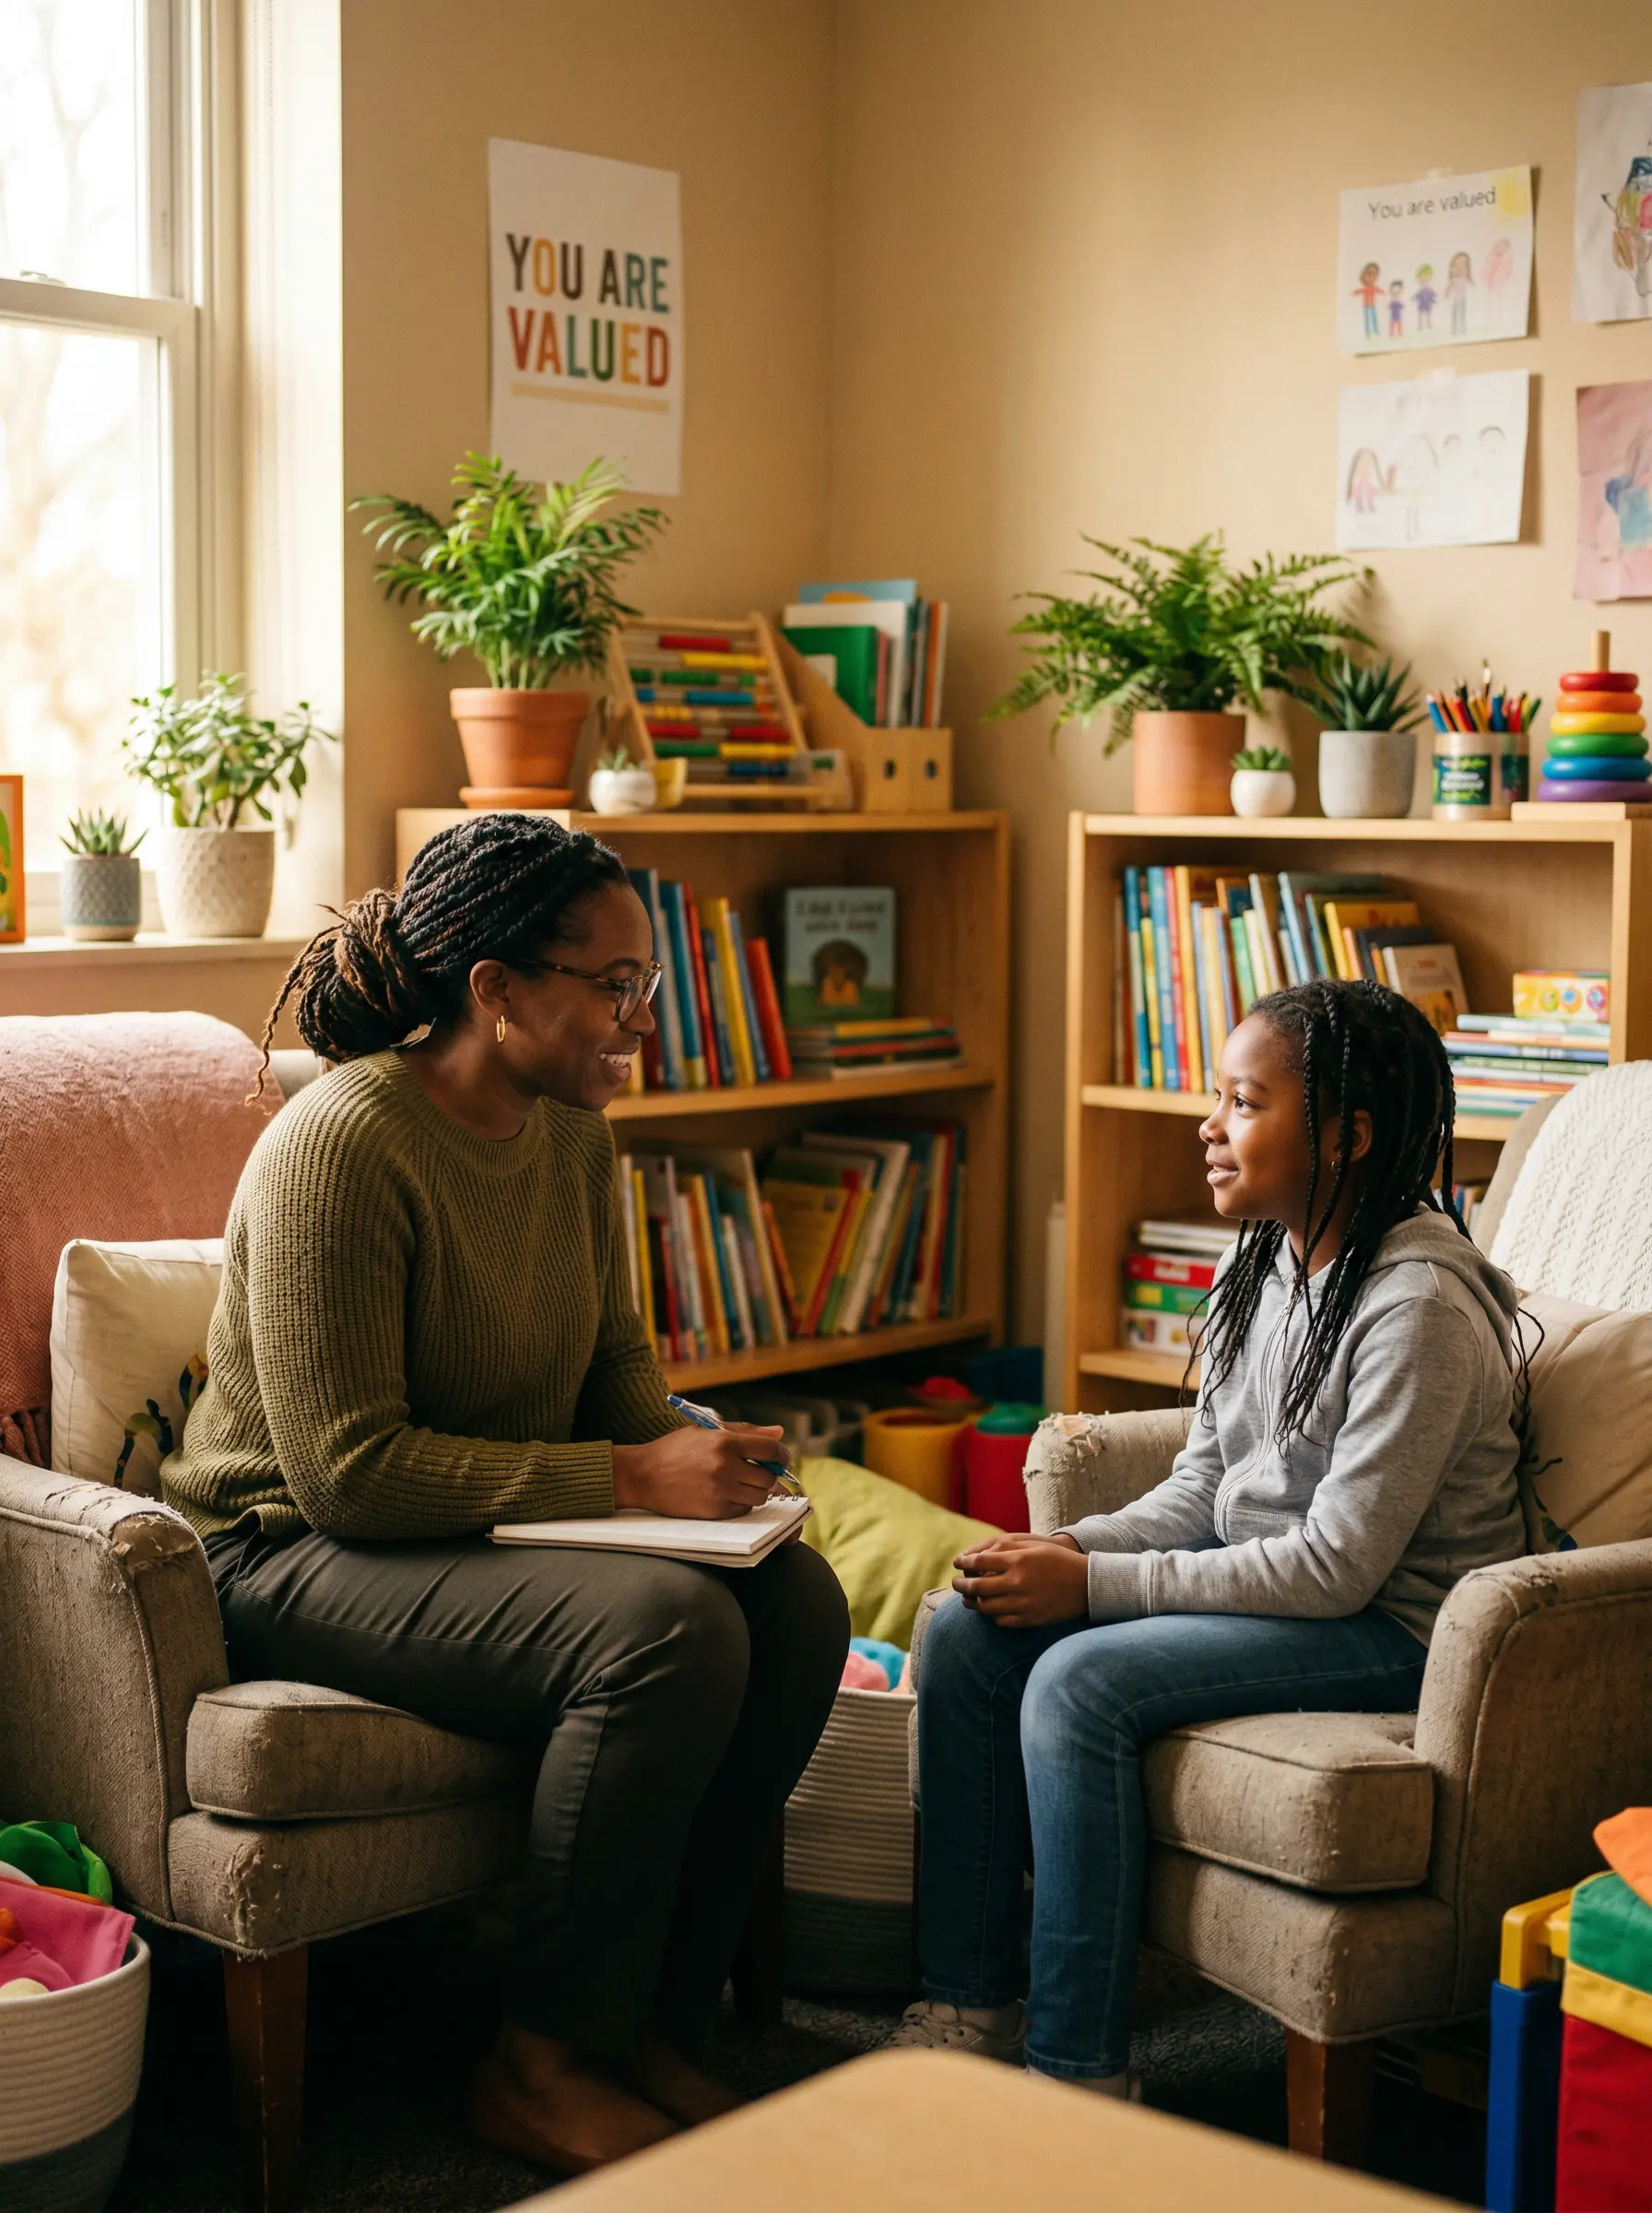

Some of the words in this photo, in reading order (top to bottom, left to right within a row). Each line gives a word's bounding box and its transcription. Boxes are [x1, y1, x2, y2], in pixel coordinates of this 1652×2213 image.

[1368, 201, 1402, 220] You
[1407, 198, 1435, 216] are
[1440, 185, 1496, 211] valued
[506, 232, 584, 301] YOU
[598, 248, 671, 314] ARE
[507, 306, 671, 388] VALUED
